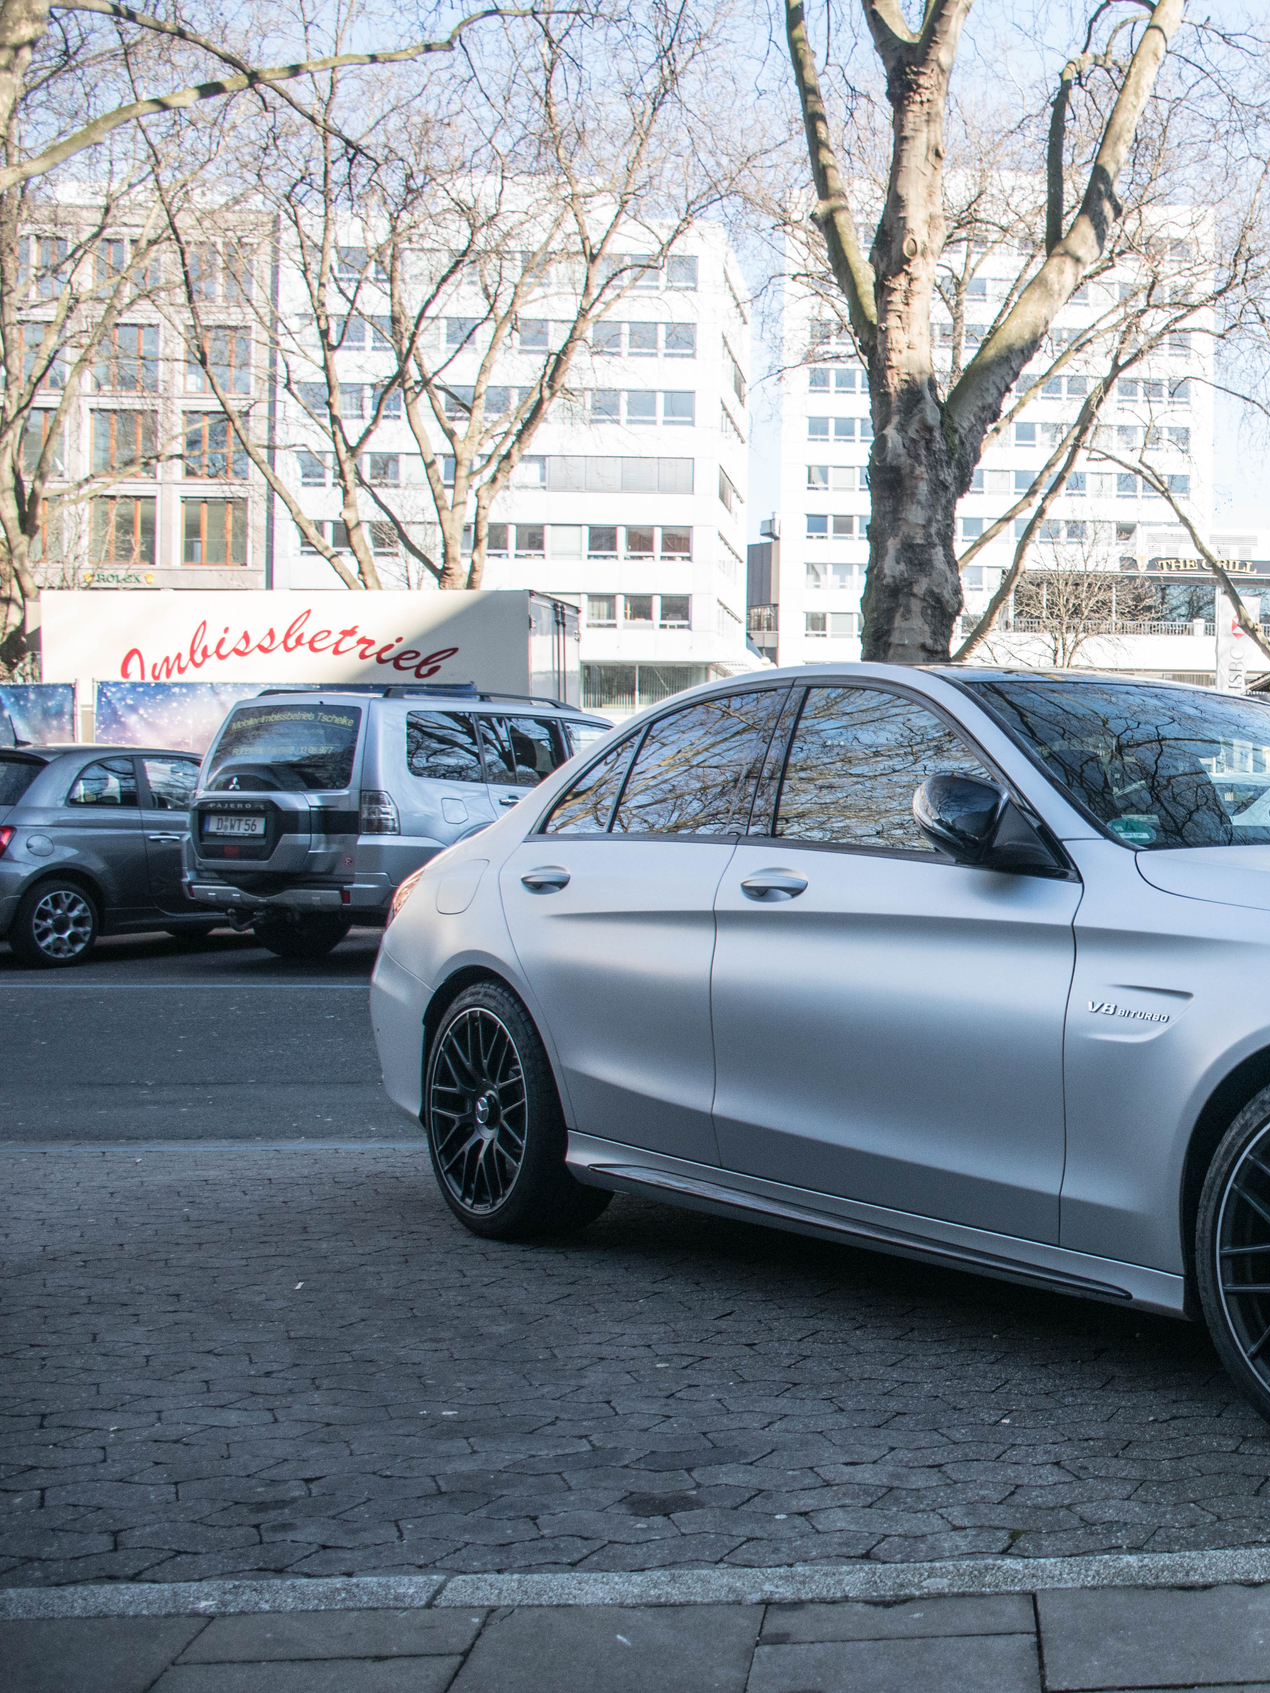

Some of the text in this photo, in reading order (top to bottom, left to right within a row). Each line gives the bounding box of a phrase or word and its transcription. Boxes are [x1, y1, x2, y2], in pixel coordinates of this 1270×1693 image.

[1158, 558, 1198, 571] THE
[96, 573, 140, 583] ROLEX
[120, 608, 466, 682] Imbissbetrieb
[216, 818, 257, 832] D WT 56
[1087, 1000, 1170, 1023] V8 BITURBO
